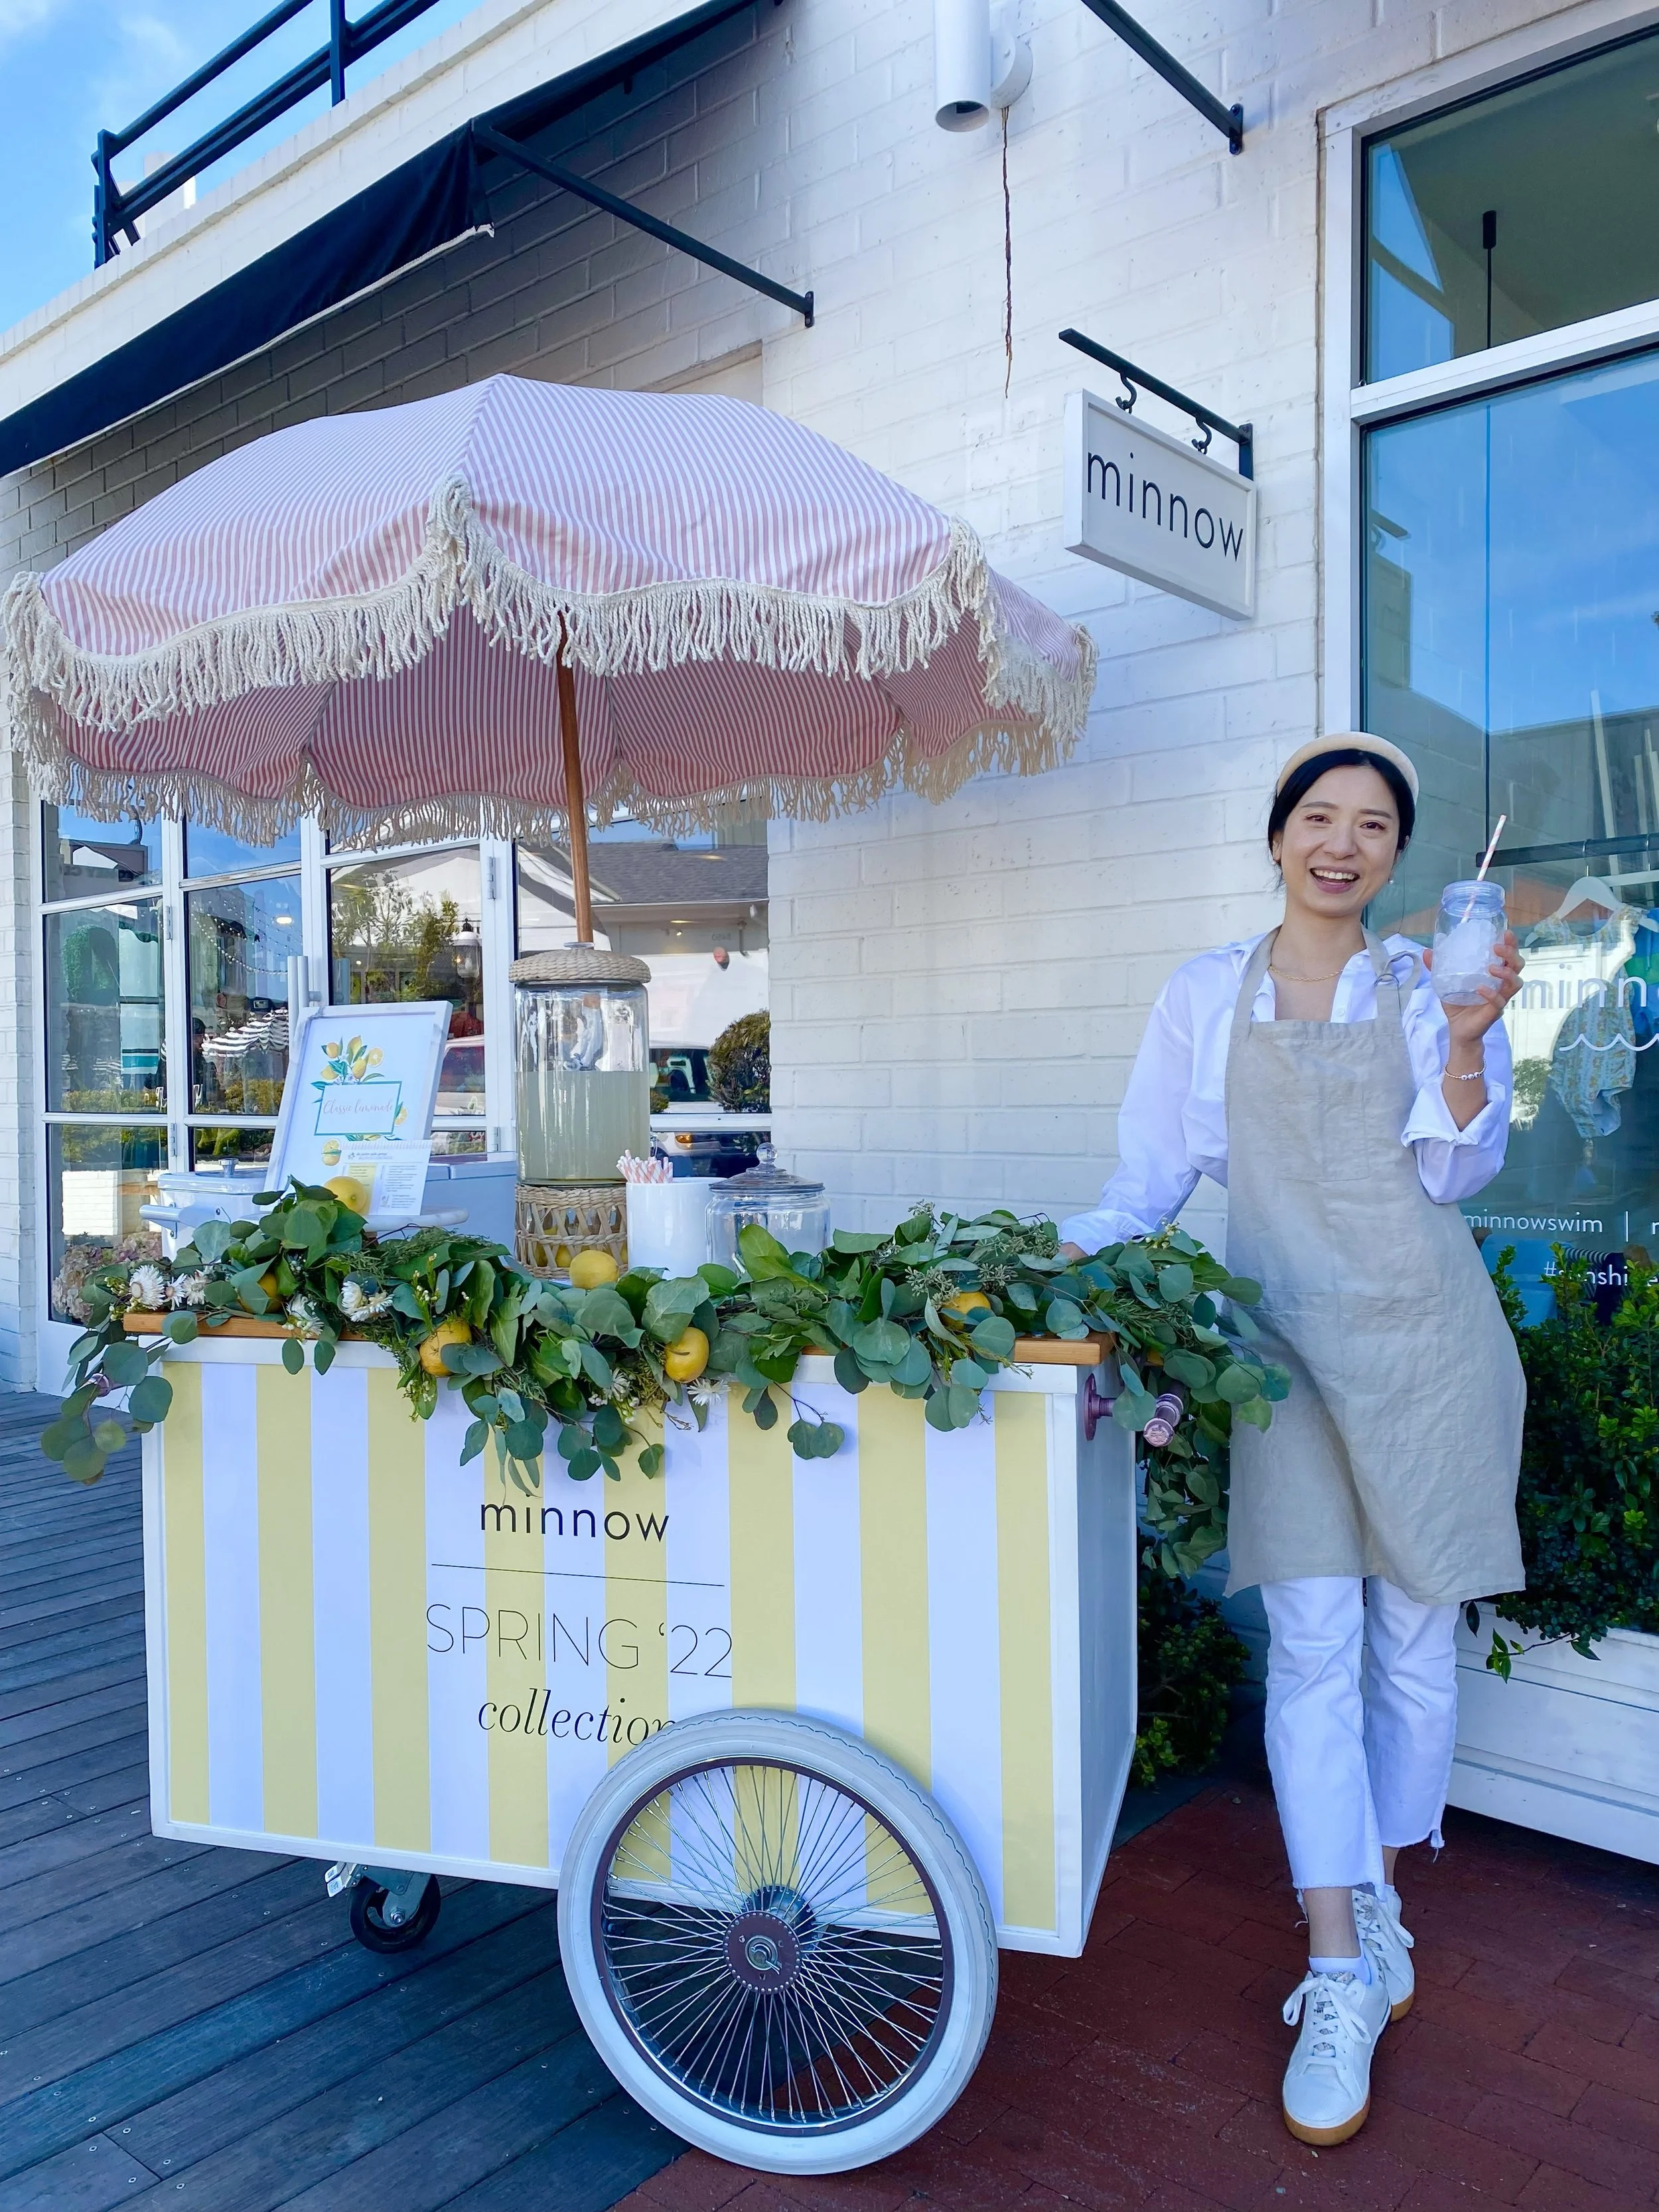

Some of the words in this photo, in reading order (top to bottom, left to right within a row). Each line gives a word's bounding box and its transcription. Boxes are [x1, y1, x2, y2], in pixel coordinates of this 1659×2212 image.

[1088, 451, 1244, 563] minnow
[481, 1493, 670, 1543] minnow
[426, 1604, 639, 1670] SPRING
